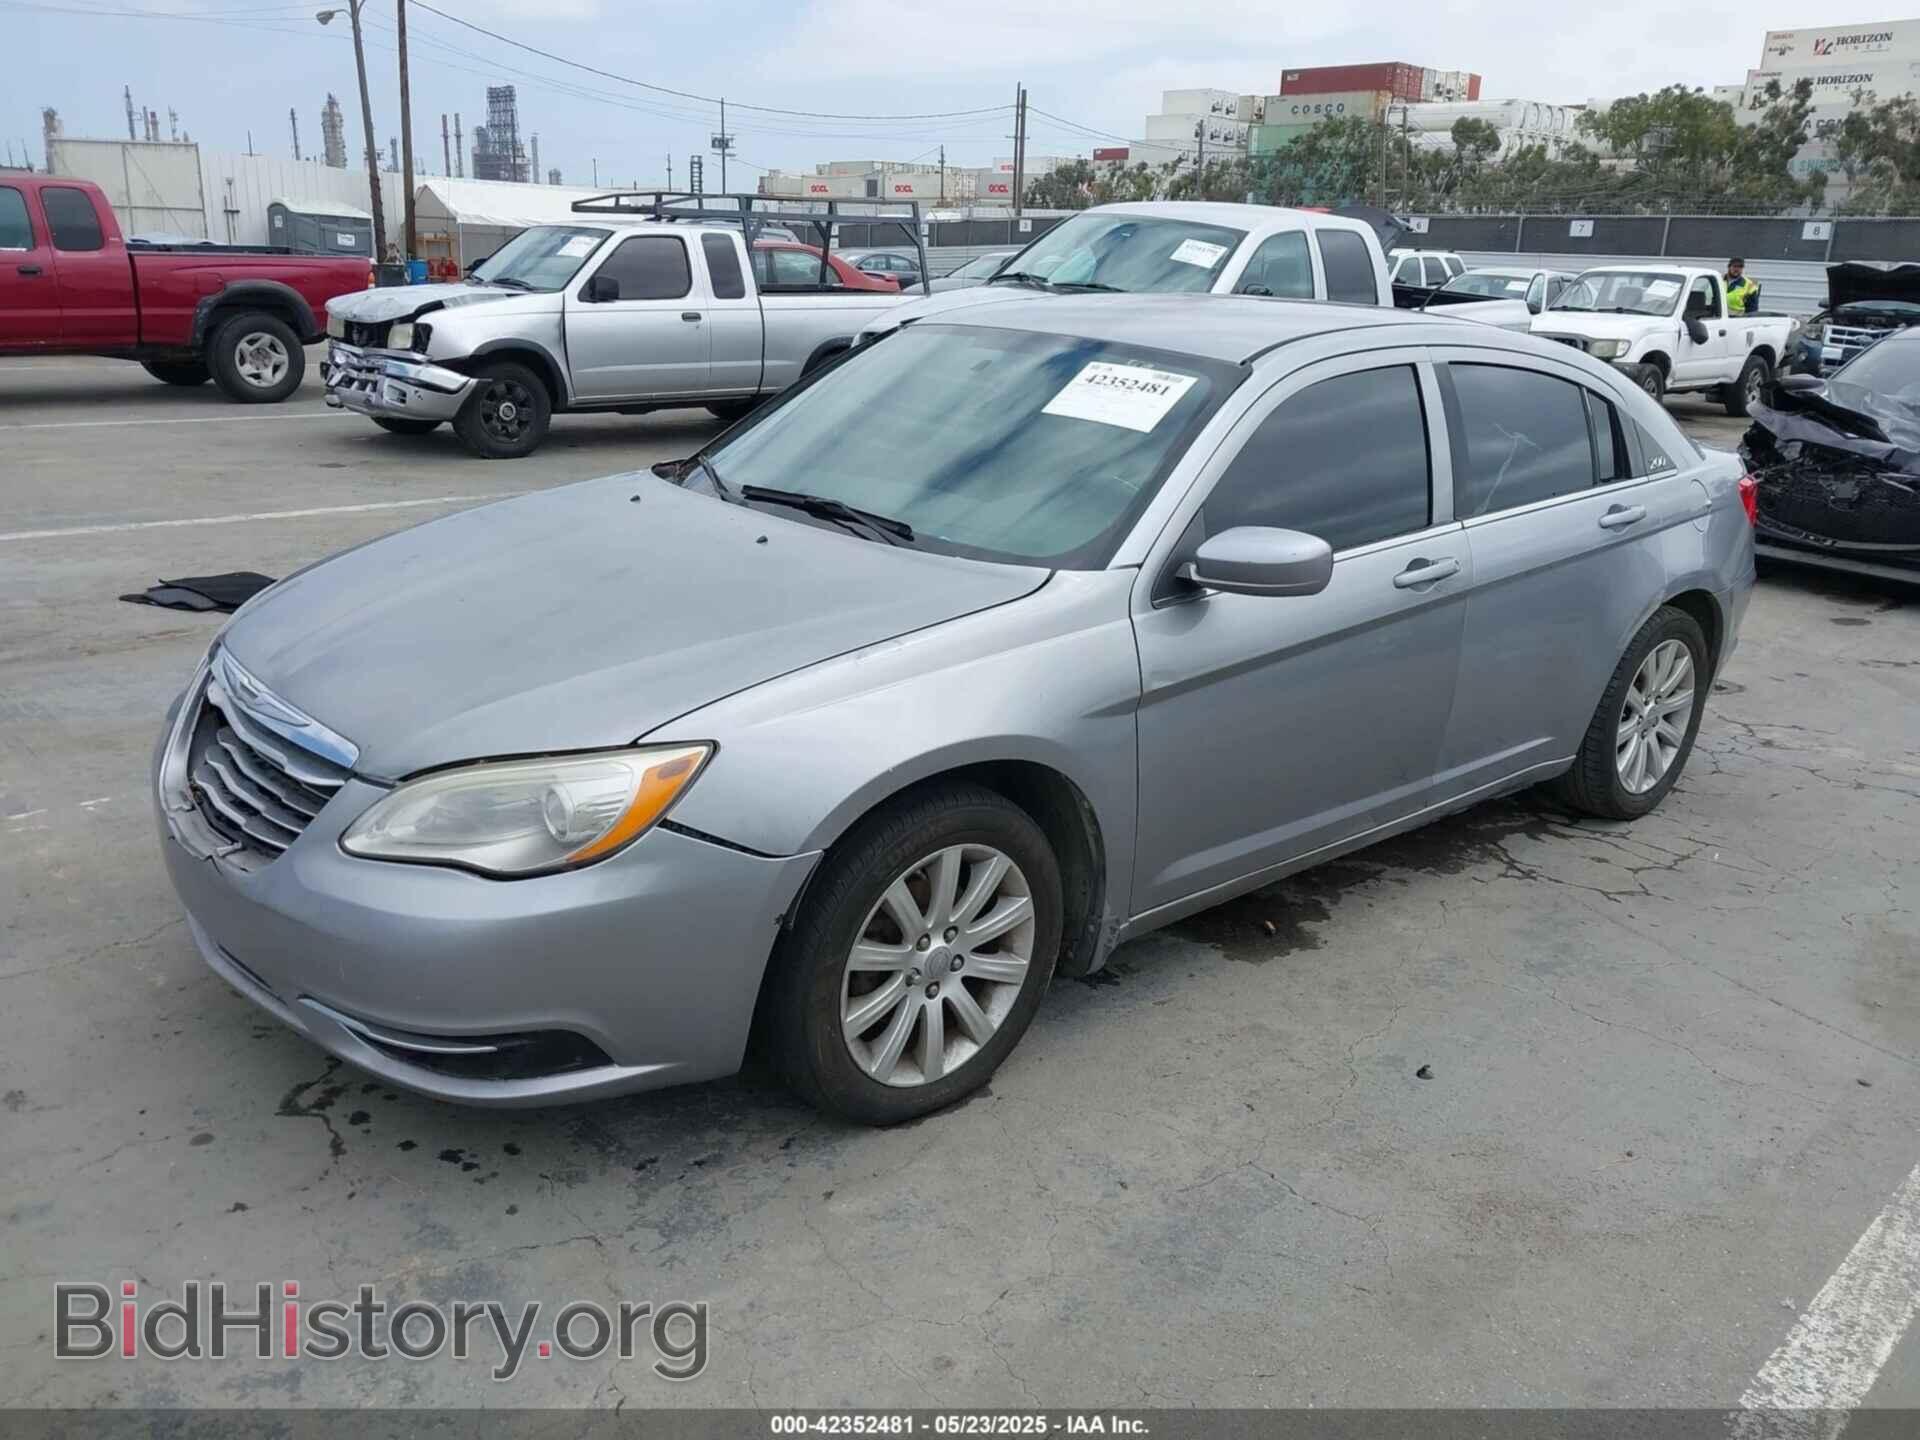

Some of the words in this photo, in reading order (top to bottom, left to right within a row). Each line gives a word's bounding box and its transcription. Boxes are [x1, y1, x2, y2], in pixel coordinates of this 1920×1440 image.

[1836, 32, 1893, 45] HORIZON
[1816, 73, 1873, 85] HORIZON
[1291, 103, 1345, 115] COSCO
[1085, 373, 1170, 396] 42352481
